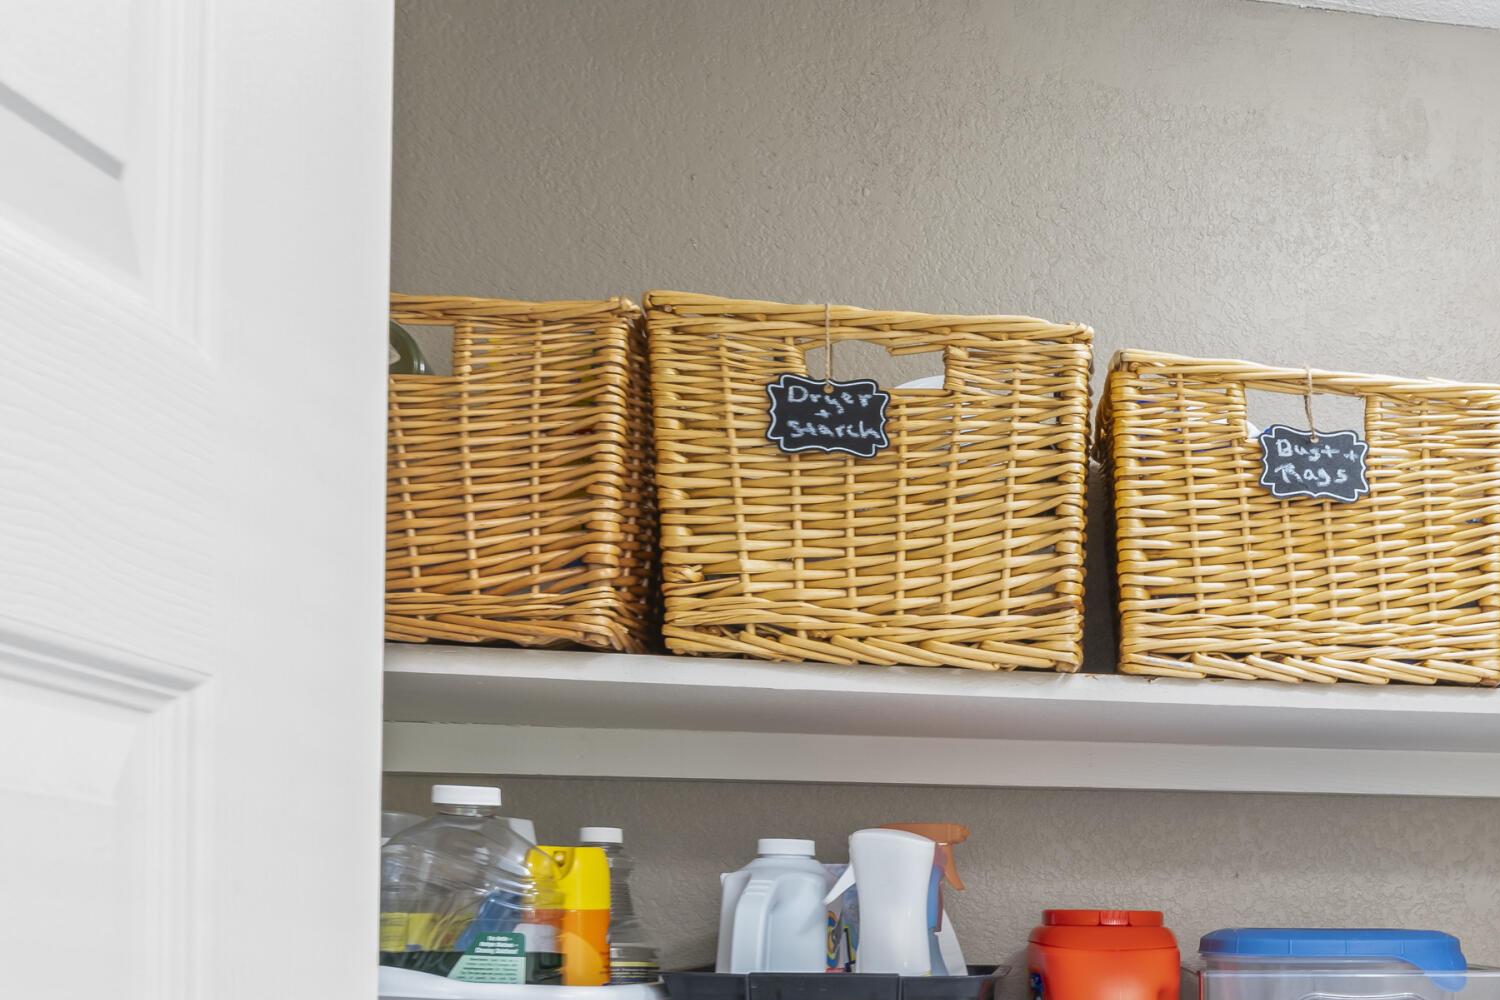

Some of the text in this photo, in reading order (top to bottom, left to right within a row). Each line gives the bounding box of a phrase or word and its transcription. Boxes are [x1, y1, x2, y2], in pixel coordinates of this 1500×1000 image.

[786, 385, 873, 414] Dryer
[786, 420, 881, 438] Starch
[1274, 463, 1348, 487] Rags
